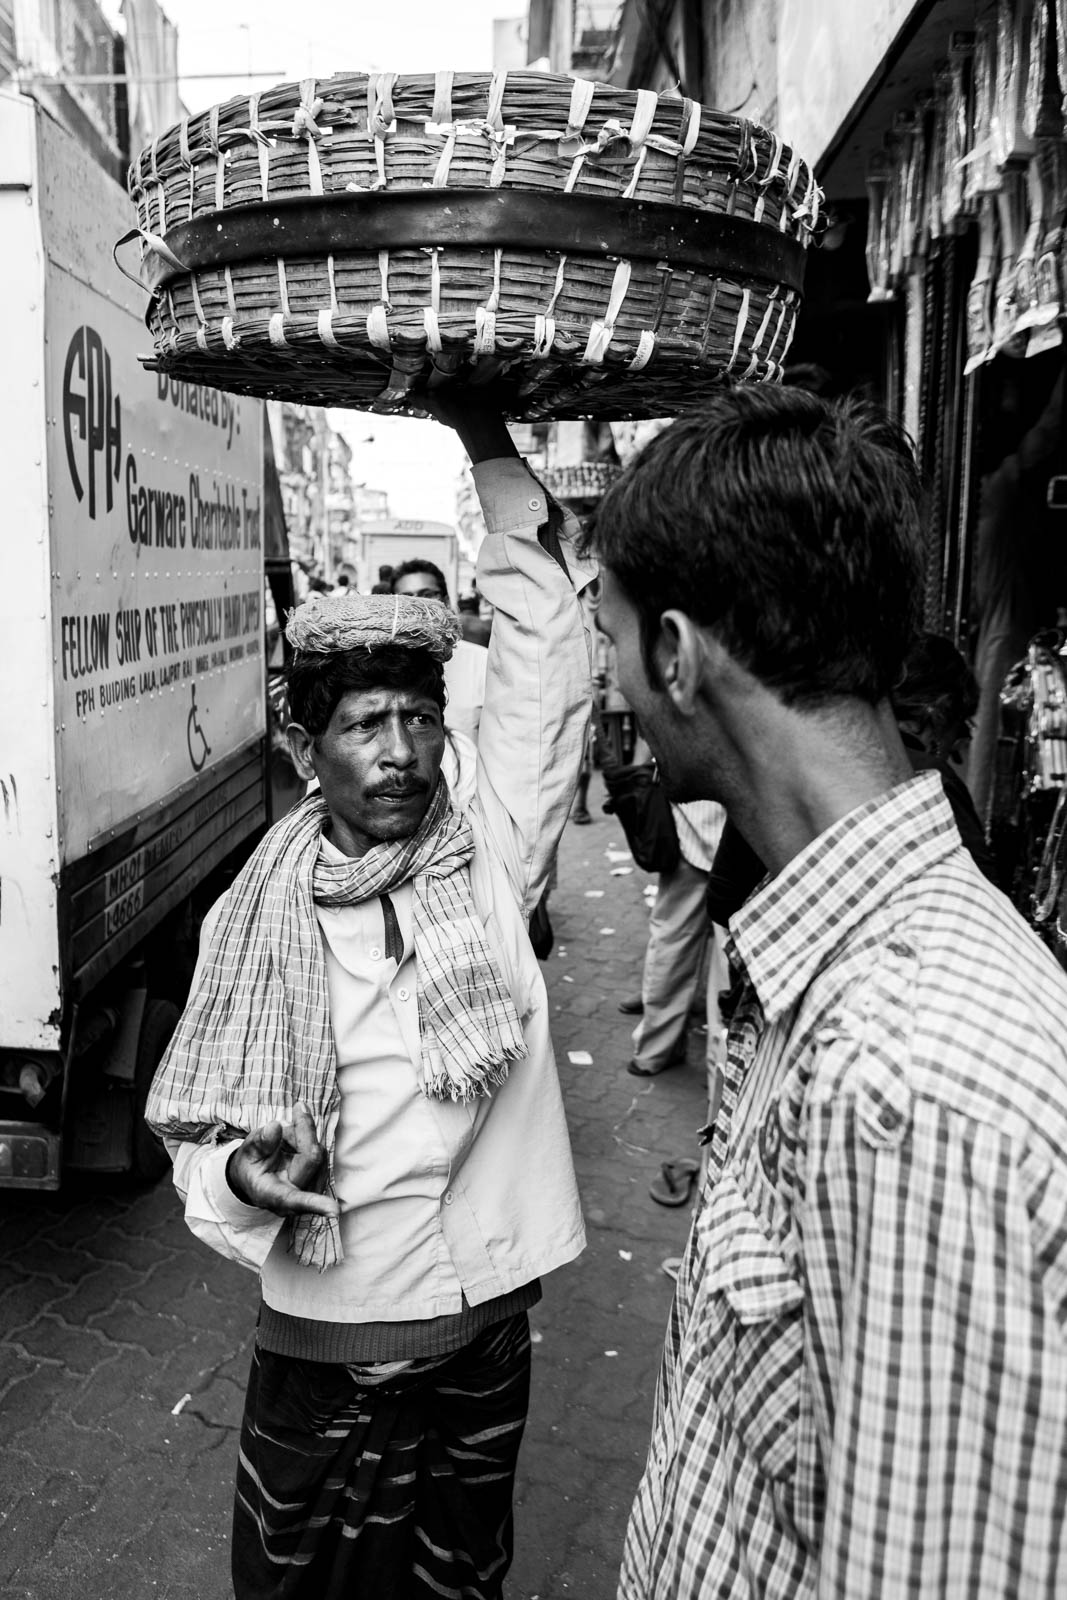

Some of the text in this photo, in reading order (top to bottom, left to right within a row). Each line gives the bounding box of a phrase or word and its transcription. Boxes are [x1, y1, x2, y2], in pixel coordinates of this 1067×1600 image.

[126, 453, 186, 549] Garware
[189, 472, 241, 550] Charitable
[61, 613, 110, 681] FELLOW
[116, 608, 141, 666] SHIP
[145, 606, 158, 658] OF
[160, 603, 179, 655] THE
[76, 687, 95, 717] FPH
[100, 677, 136, 708] BUIDING
